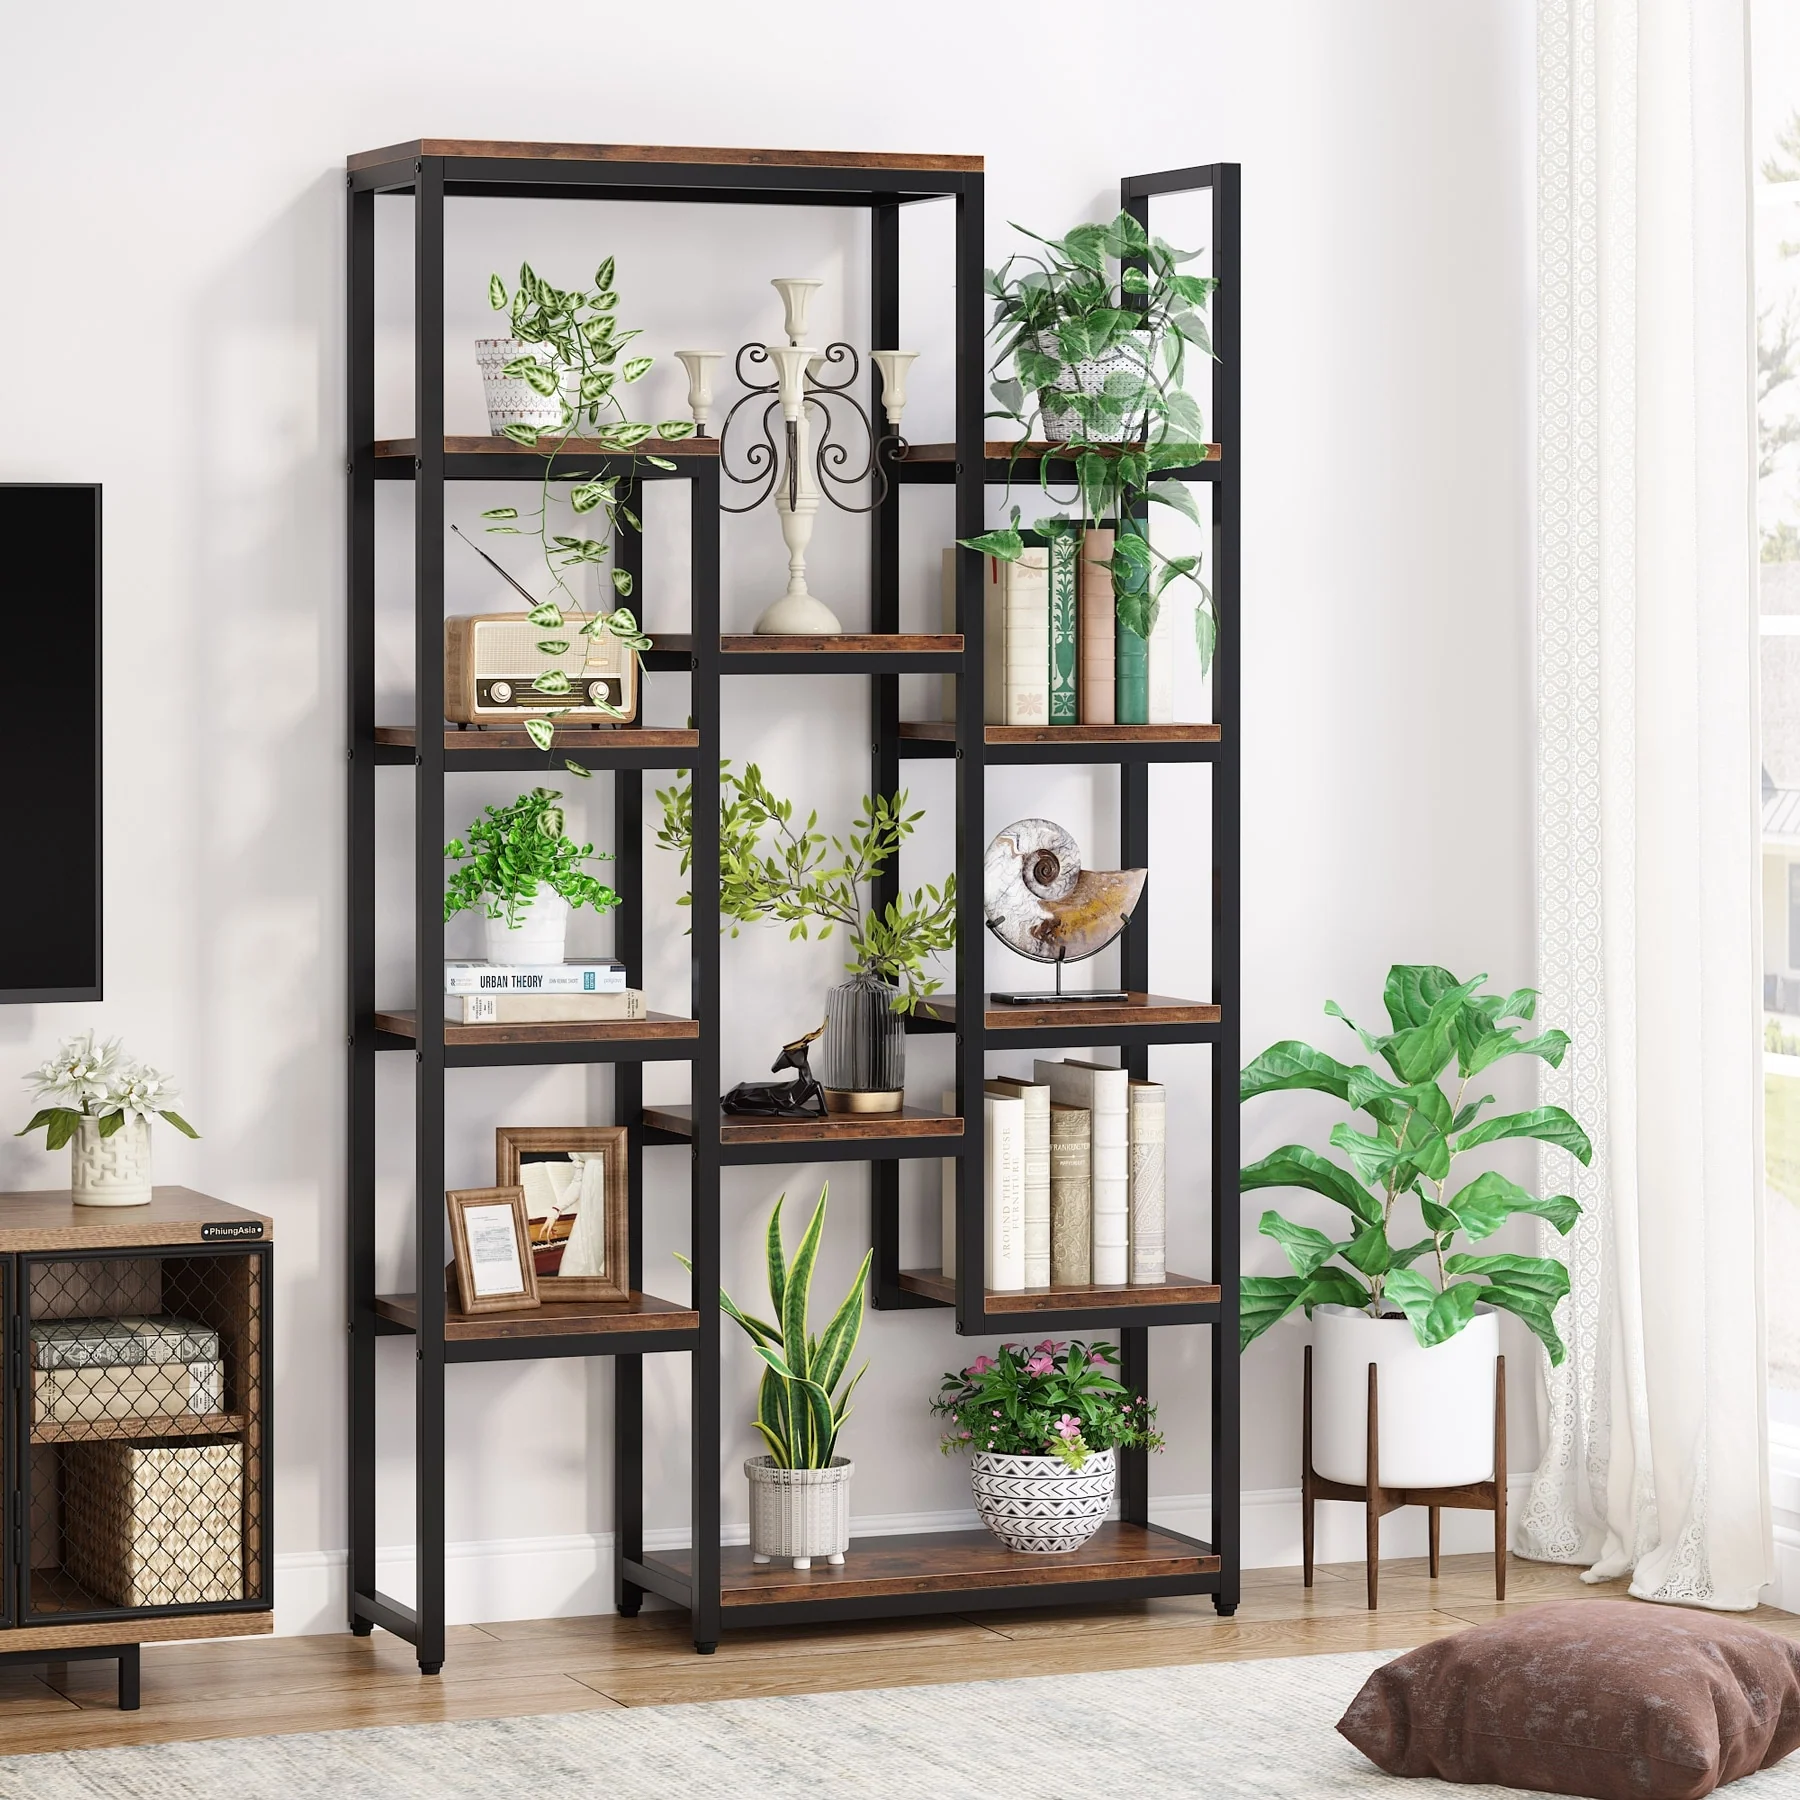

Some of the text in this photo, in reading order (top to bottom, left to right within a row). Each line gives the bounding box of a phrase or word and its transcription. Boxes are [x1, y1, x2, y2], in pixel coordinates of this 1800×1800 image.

[480, 975, 543, 988] URBAN THEORY
[1002, 1127, 1011, 1260] AROUND THE HOUSE
[1012, 1157, 1021, 1230] FURNITURE
[209, 1226, 256, 1236] PhiungAsia
